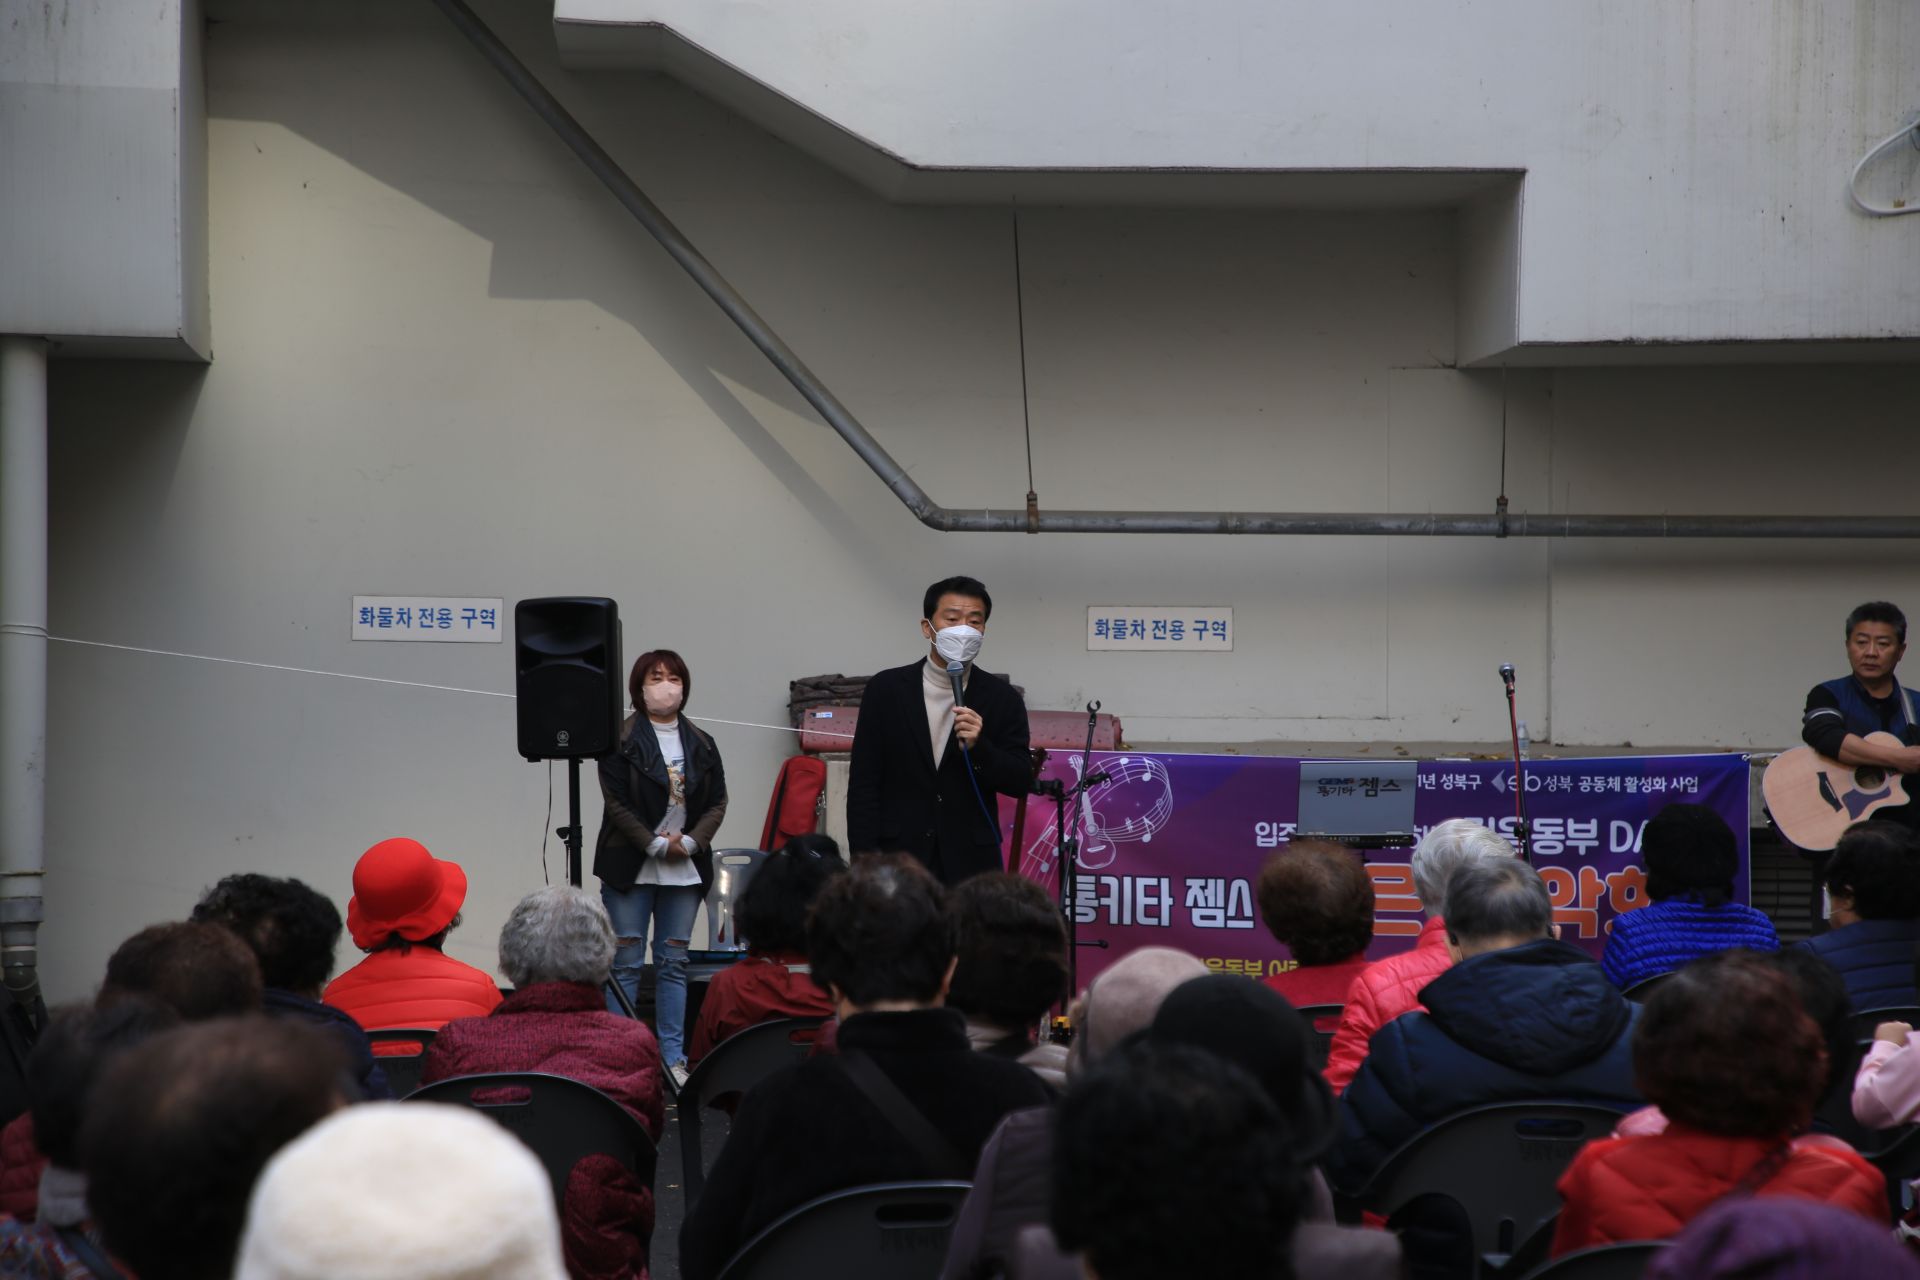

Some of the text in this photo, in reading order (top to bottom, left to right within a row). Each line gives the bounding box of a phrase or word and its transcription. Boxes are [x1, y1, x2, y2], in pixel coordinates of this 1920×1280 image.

[358, 606, 496, 630] 화물차 전용 구역
[1094, 618, 1227, 642] 화물차 전용 구역
[1359, 777, 1402, 797] 젬스
[1440, 773, 1483, 791] 성북구
[1544, 775, 1574, 793] 성북
[1578, 776, 1621, 793] 공동체
[1624, 776, 1668, 793] 활성화
[1670, 776, 1699, 793] 사업
[1185, 878, 1254, 929] 젬스
